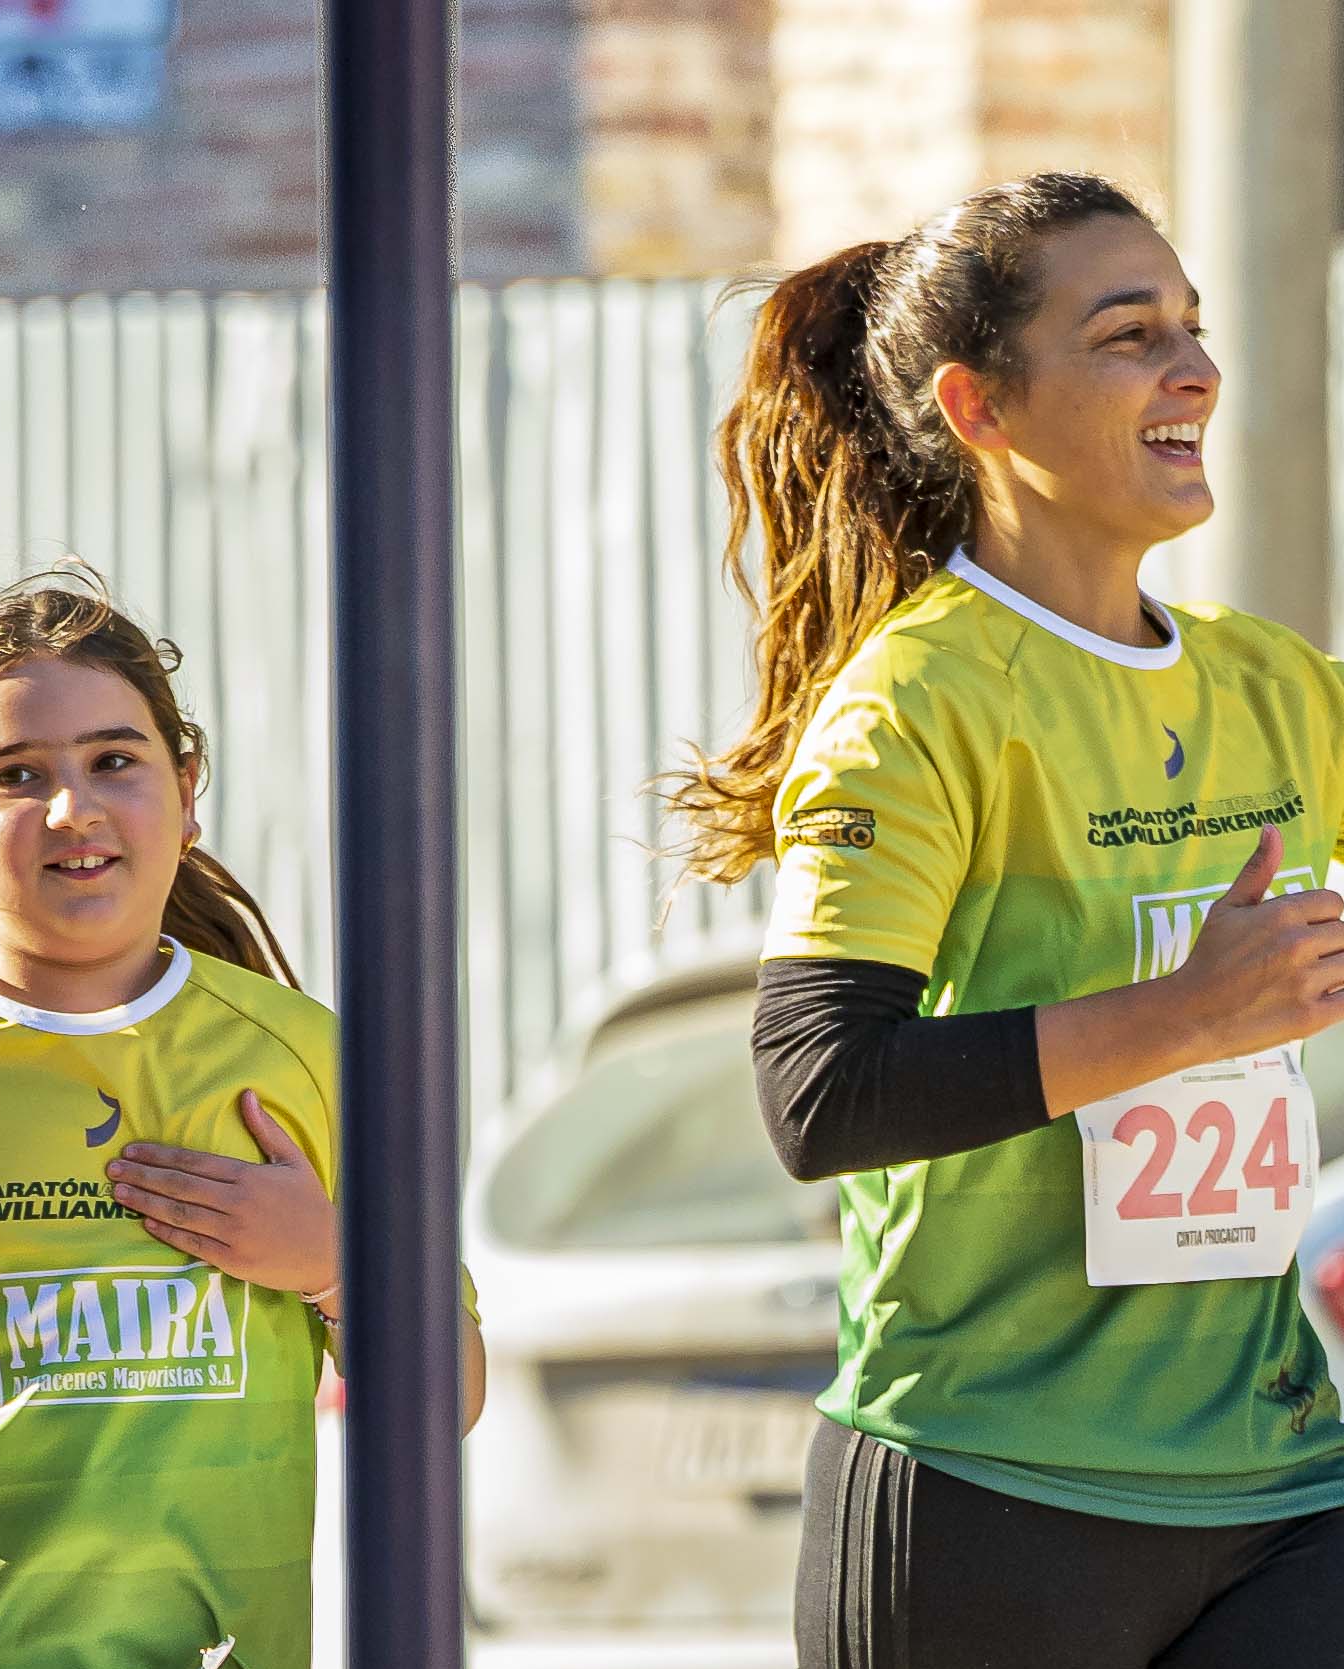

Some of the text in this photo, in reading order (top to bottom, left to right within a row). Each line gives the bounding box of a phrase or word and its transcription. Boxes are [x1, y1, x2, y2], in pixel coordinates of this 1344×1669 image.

[1112, 1097, 1299, 1221] 224
[4, 1272, 236, 1369] MAIRA
[113, 1366, 204, 1391] Mayoristas
[208, 1364, 236, 1387] S.A.
